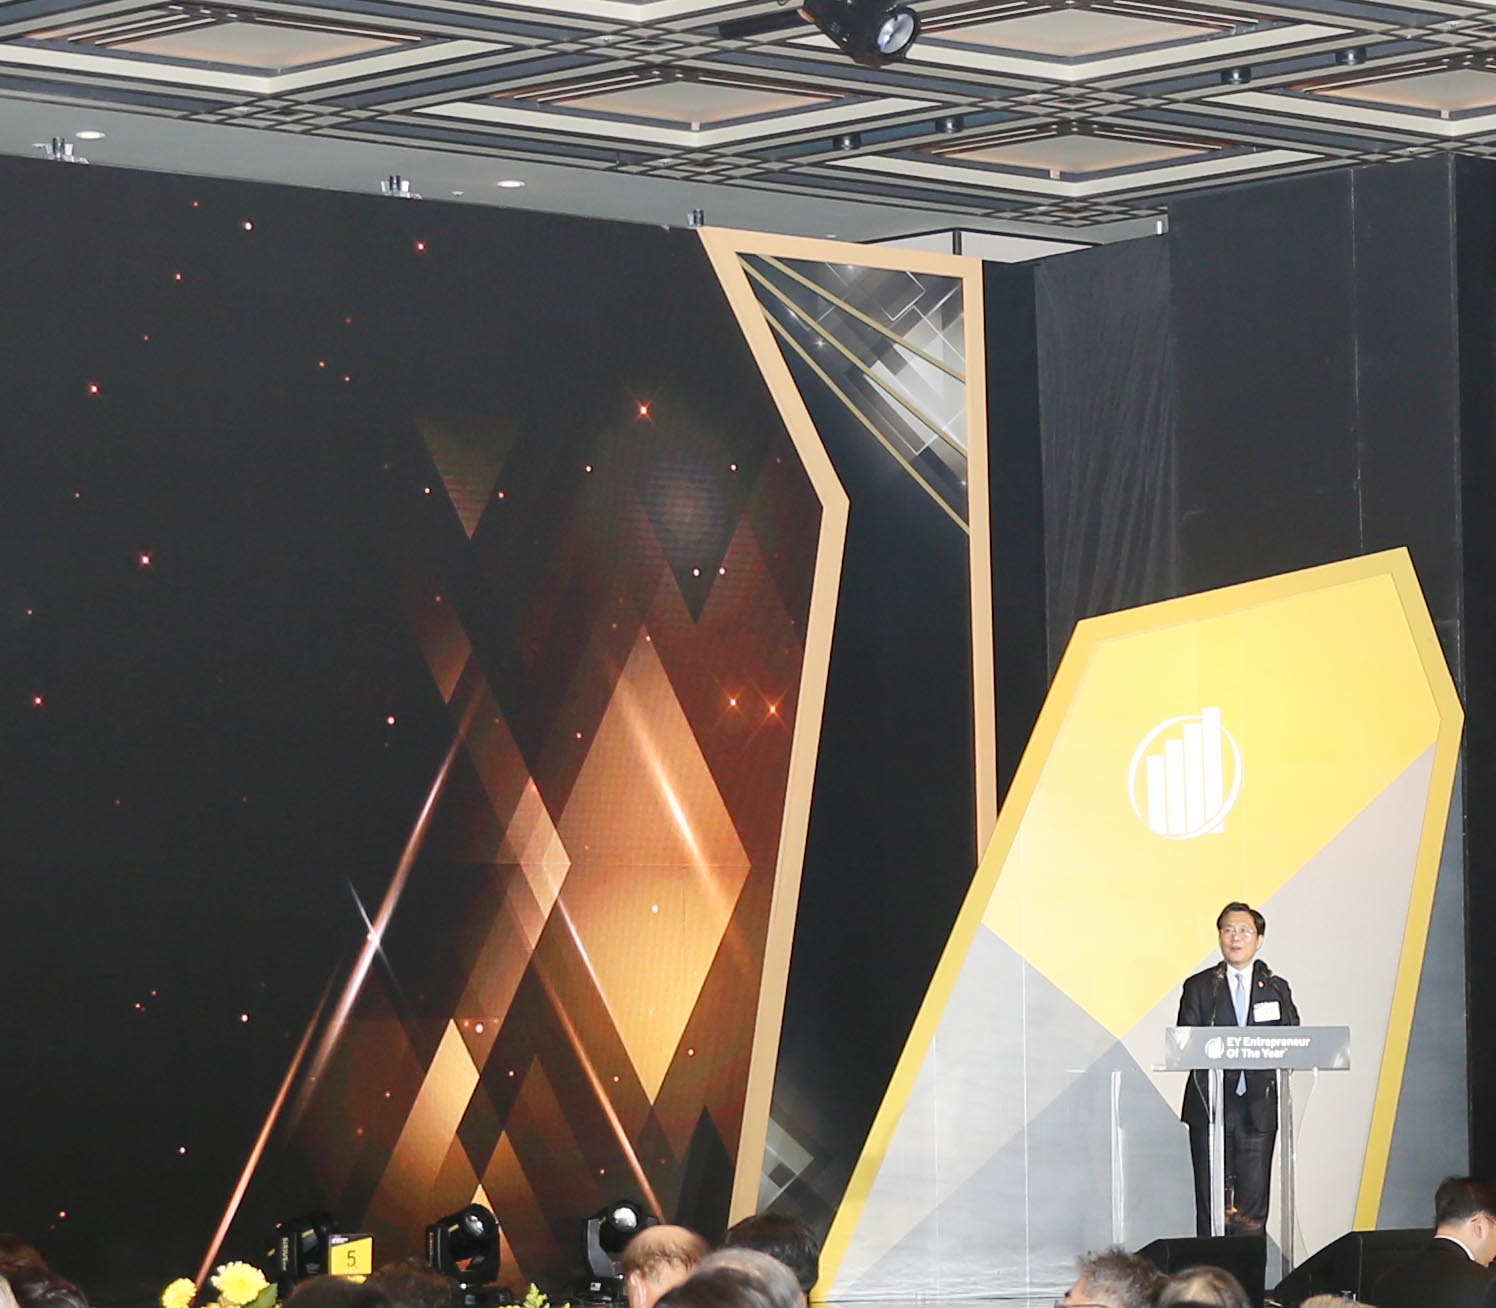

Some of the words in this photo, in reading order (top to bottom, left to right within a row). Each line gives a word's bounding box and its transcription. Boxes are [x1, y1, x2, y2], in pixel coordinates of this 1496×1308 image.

[1226, 1036, 1242, 1047] EY
[1242, 1036, 1311, 1049] Entrepreneur
[1226, 1048, 1239, 1059] Of
[1241, 1048, 1261, 1059] The
[346, 1250, 357, 1268] 5
